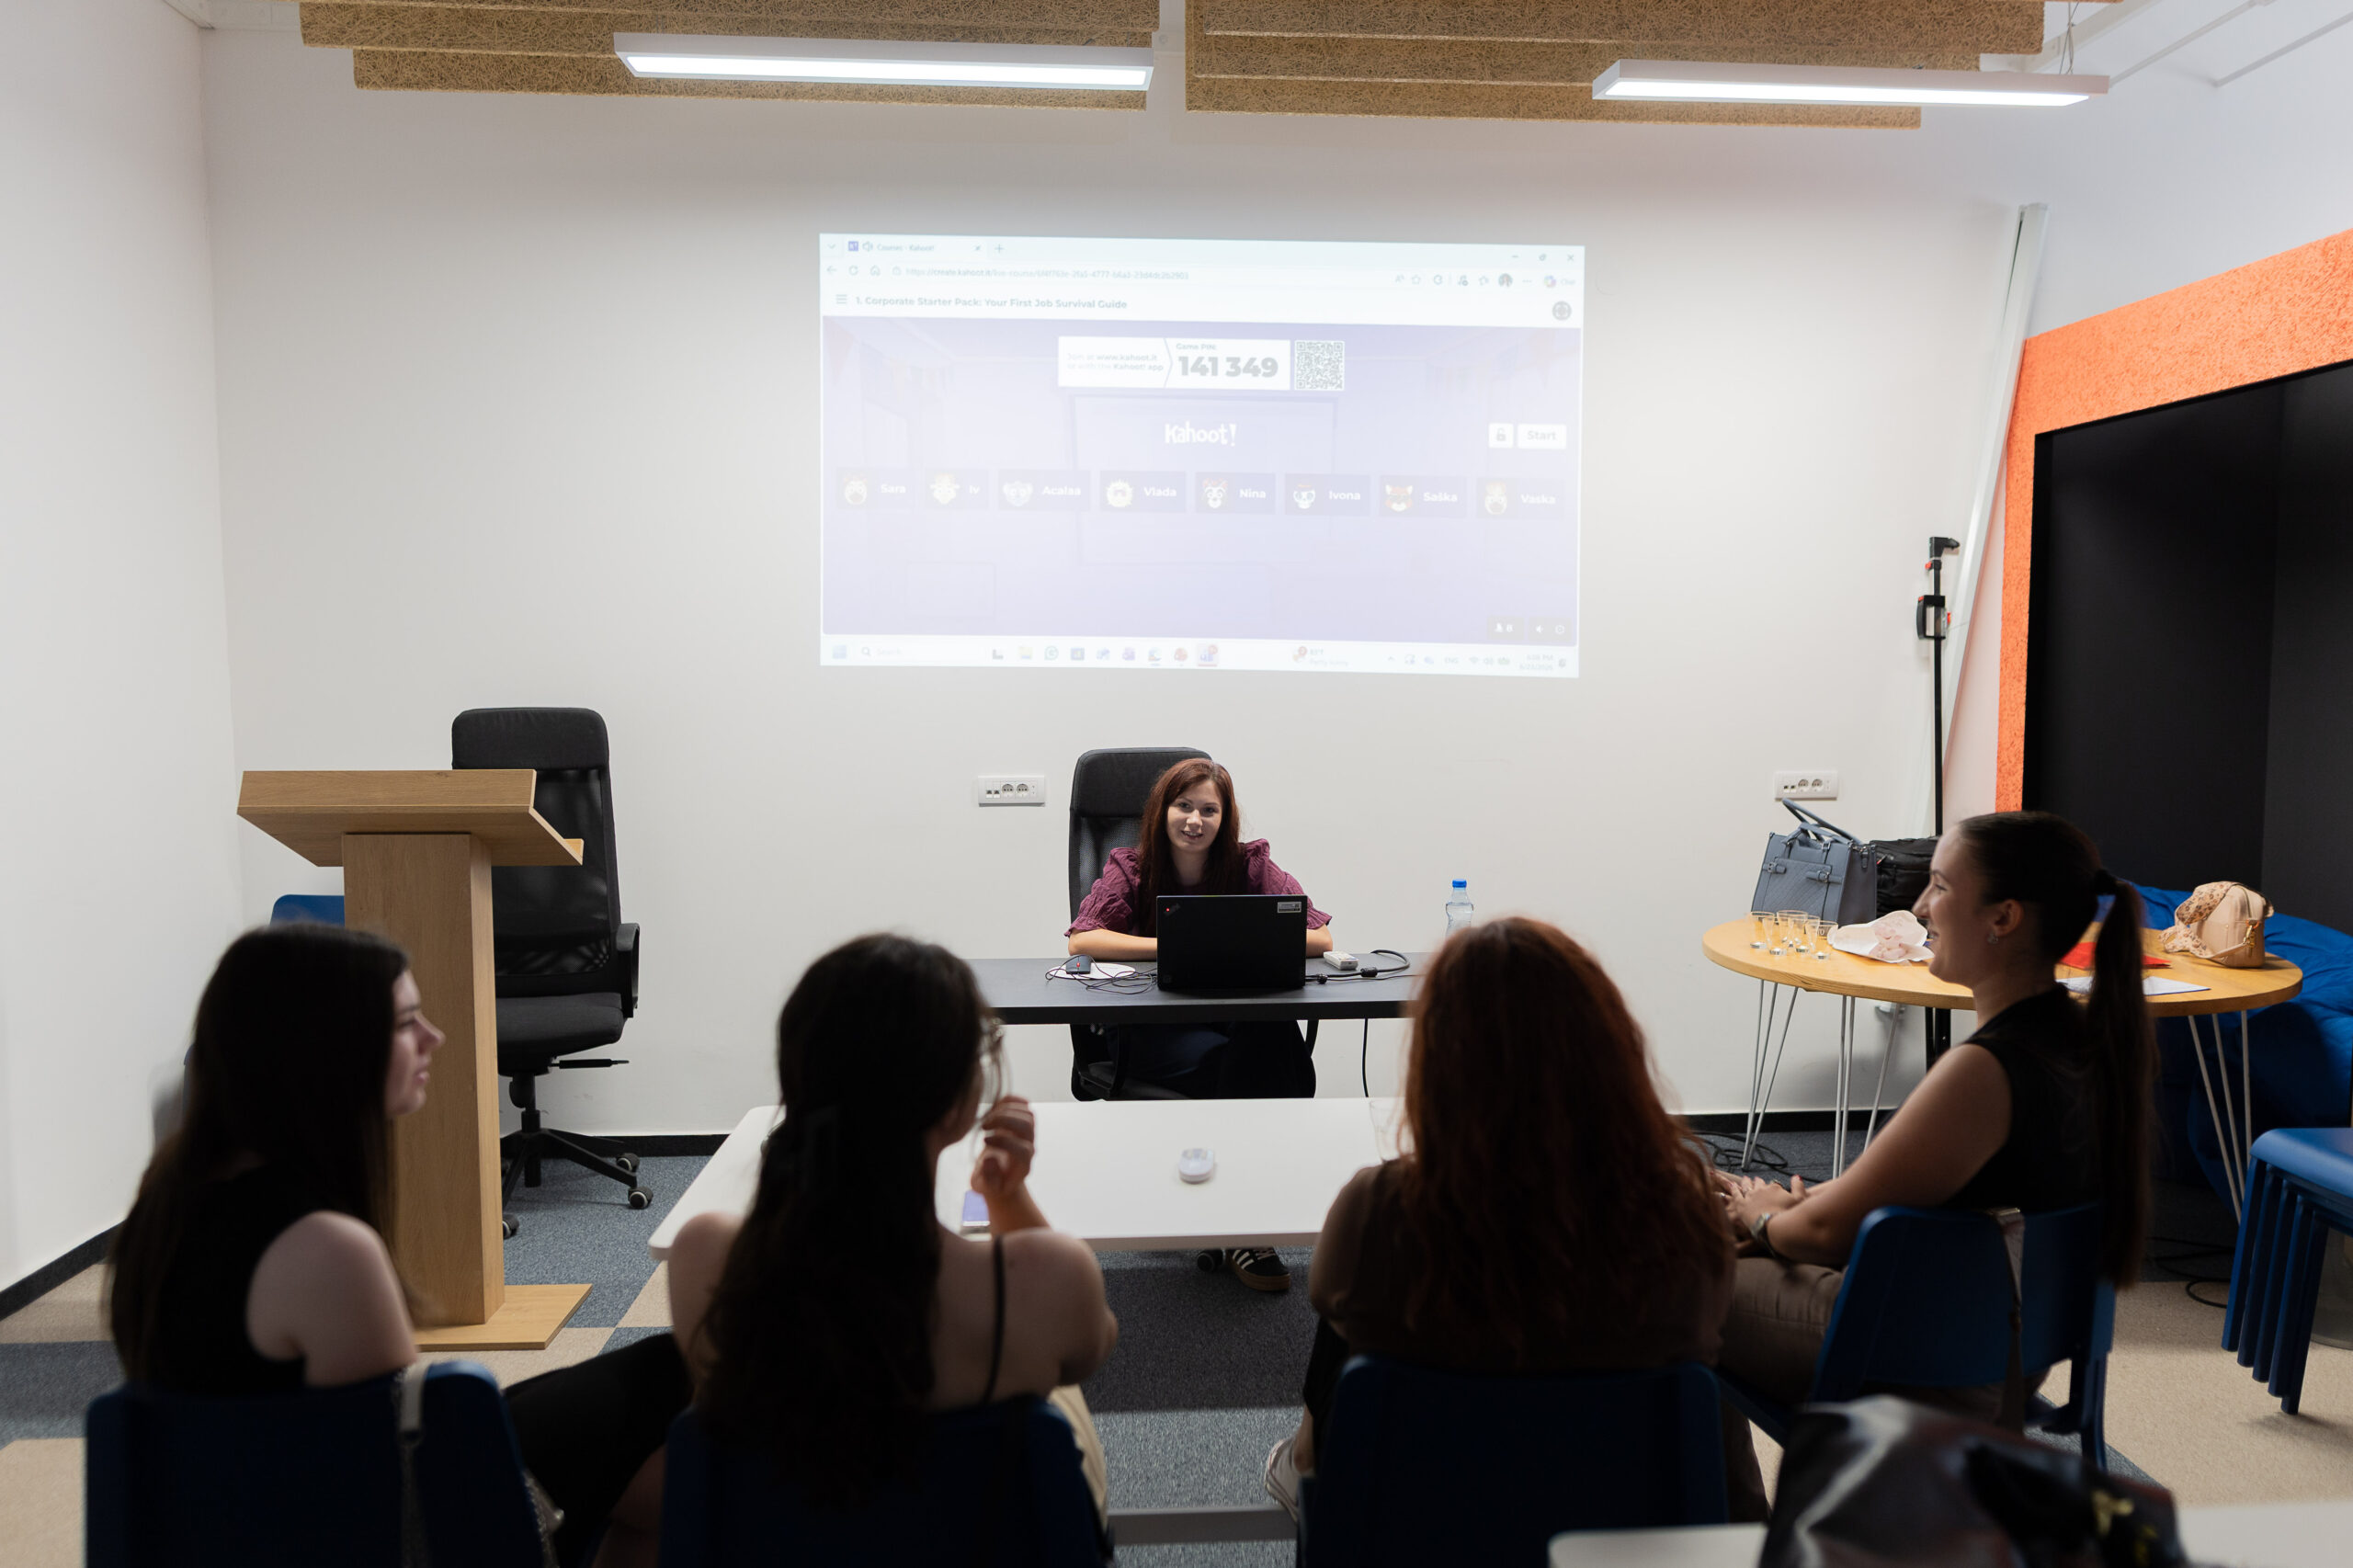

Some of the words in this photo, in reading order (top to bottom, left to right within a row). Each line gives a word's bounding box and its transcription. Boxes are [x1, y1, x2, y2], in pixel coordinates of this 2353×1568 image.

[856, 297, 862, 305] 1.
[865, 297, 915, 308] Corporate
[917, 297, 952, 306] Starter
[955, 298, 982, 306] Pack:
[984, 299, 1007, 307] Your
[1010, 299, 1032, 307] First
[1035, 299, 1053, 307] Job
[1055, 300, 1096, 308] Survival
[1097, 301, 1128, 309] Guide
[1147, 364, 1164, 372] app
[1178, 356, 1219, 377] 141
[1224, 357, 1279, 378] 349
[1164, 420, 1237, 447] Kahoot!
[1527, 430, 1557, 441] Start
[880, 483, 907, 494] Sara
[968, 484, 980, 494] Iv
[1040, 484, 1083, 496] Acalaa
[1142, 486, 1177, 497] Vlada
[1238, 487, 1267, 499] Nina
[1327, 489, 1361, 501] Ivona
[1423, 489, 1459, 502] Saška
[1519, 493, 1556, 505] Vaska
